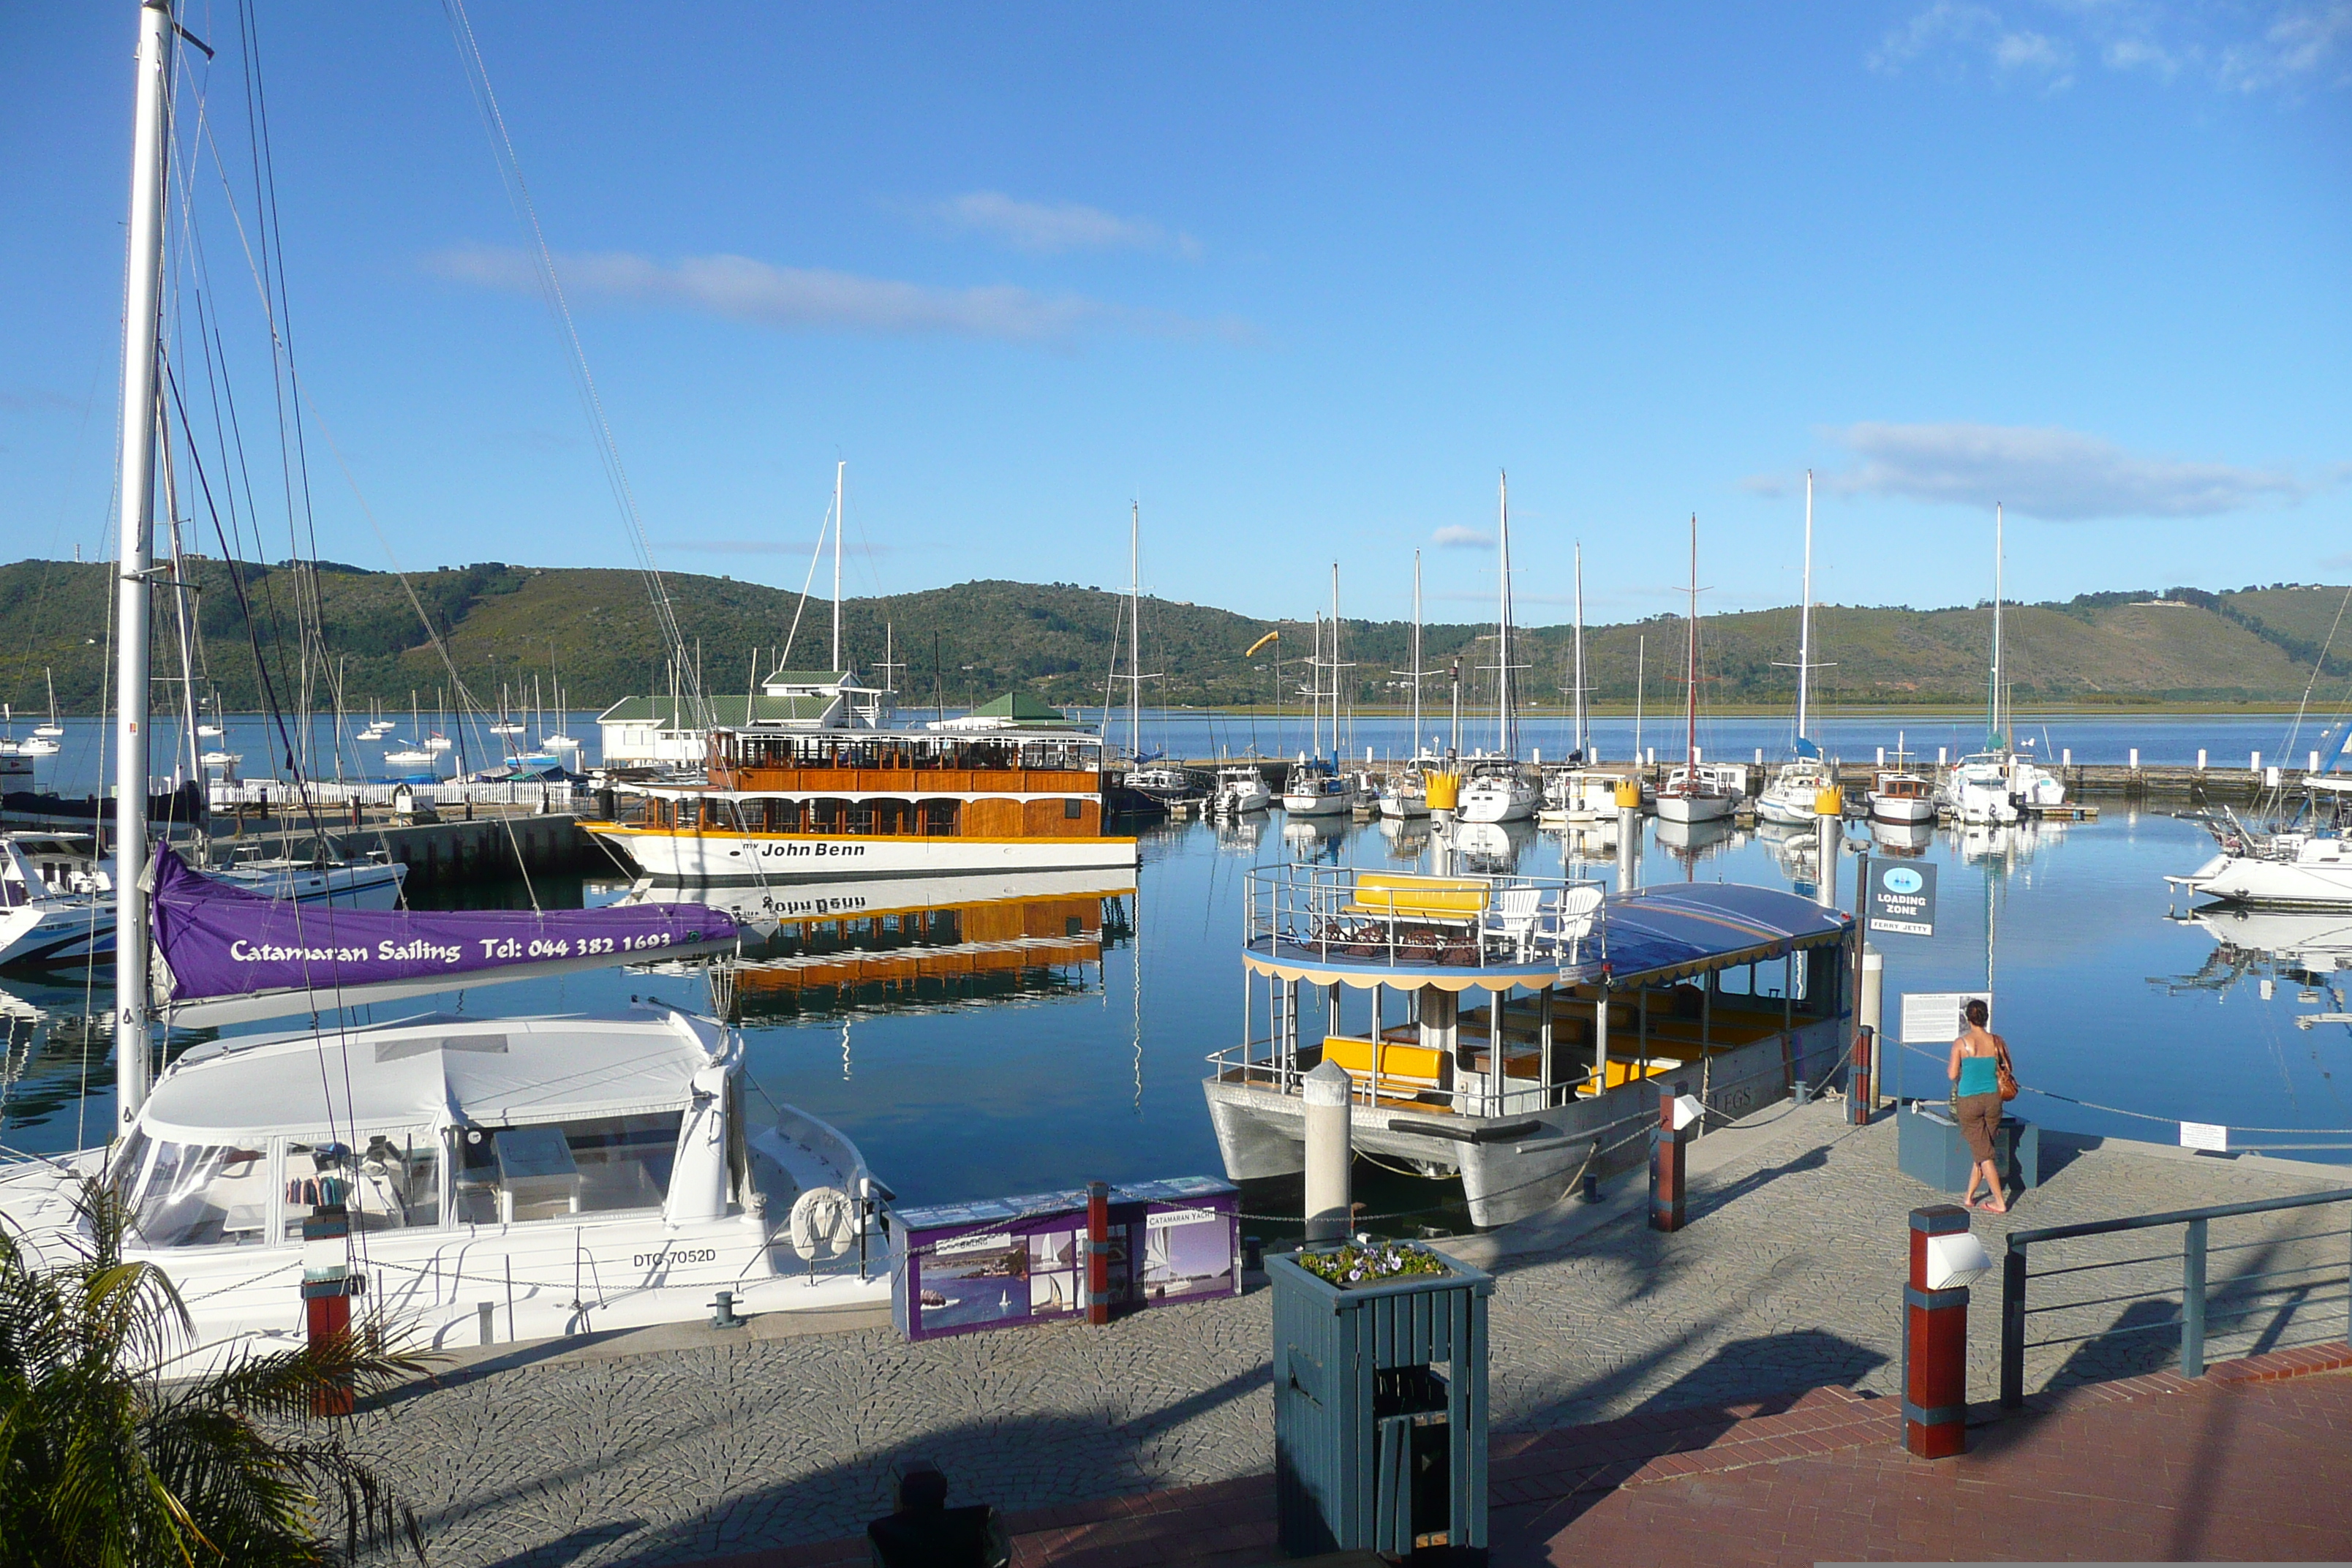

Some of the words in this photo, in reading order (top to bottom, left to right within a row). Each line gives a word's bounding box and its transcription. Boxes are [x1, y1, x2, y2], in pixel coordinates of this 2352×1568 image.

[762, 843, 810, 856] John
[815, 843, 864, 856] Benn
[1877, 894, 1926, 906] LOADING
[1886, 904, 1918, 916] ZONE
[1903, 924, 1927, 932] JETTY
[230, 940, 368, 962] Catamaran
[378, 938, 461, 963] Sailing
[478, 938, 522, 959] Tel:
[528, 938, 569, 957] 044
[576, 938, 614, 956] 382
[622, 932, 671, 951] 1693
[1149, 1214, 1190, 1226] CATAMARAN
[634, 1253, 663, 1267] DTC
[669, 1249, 716, 1264] 7052D
